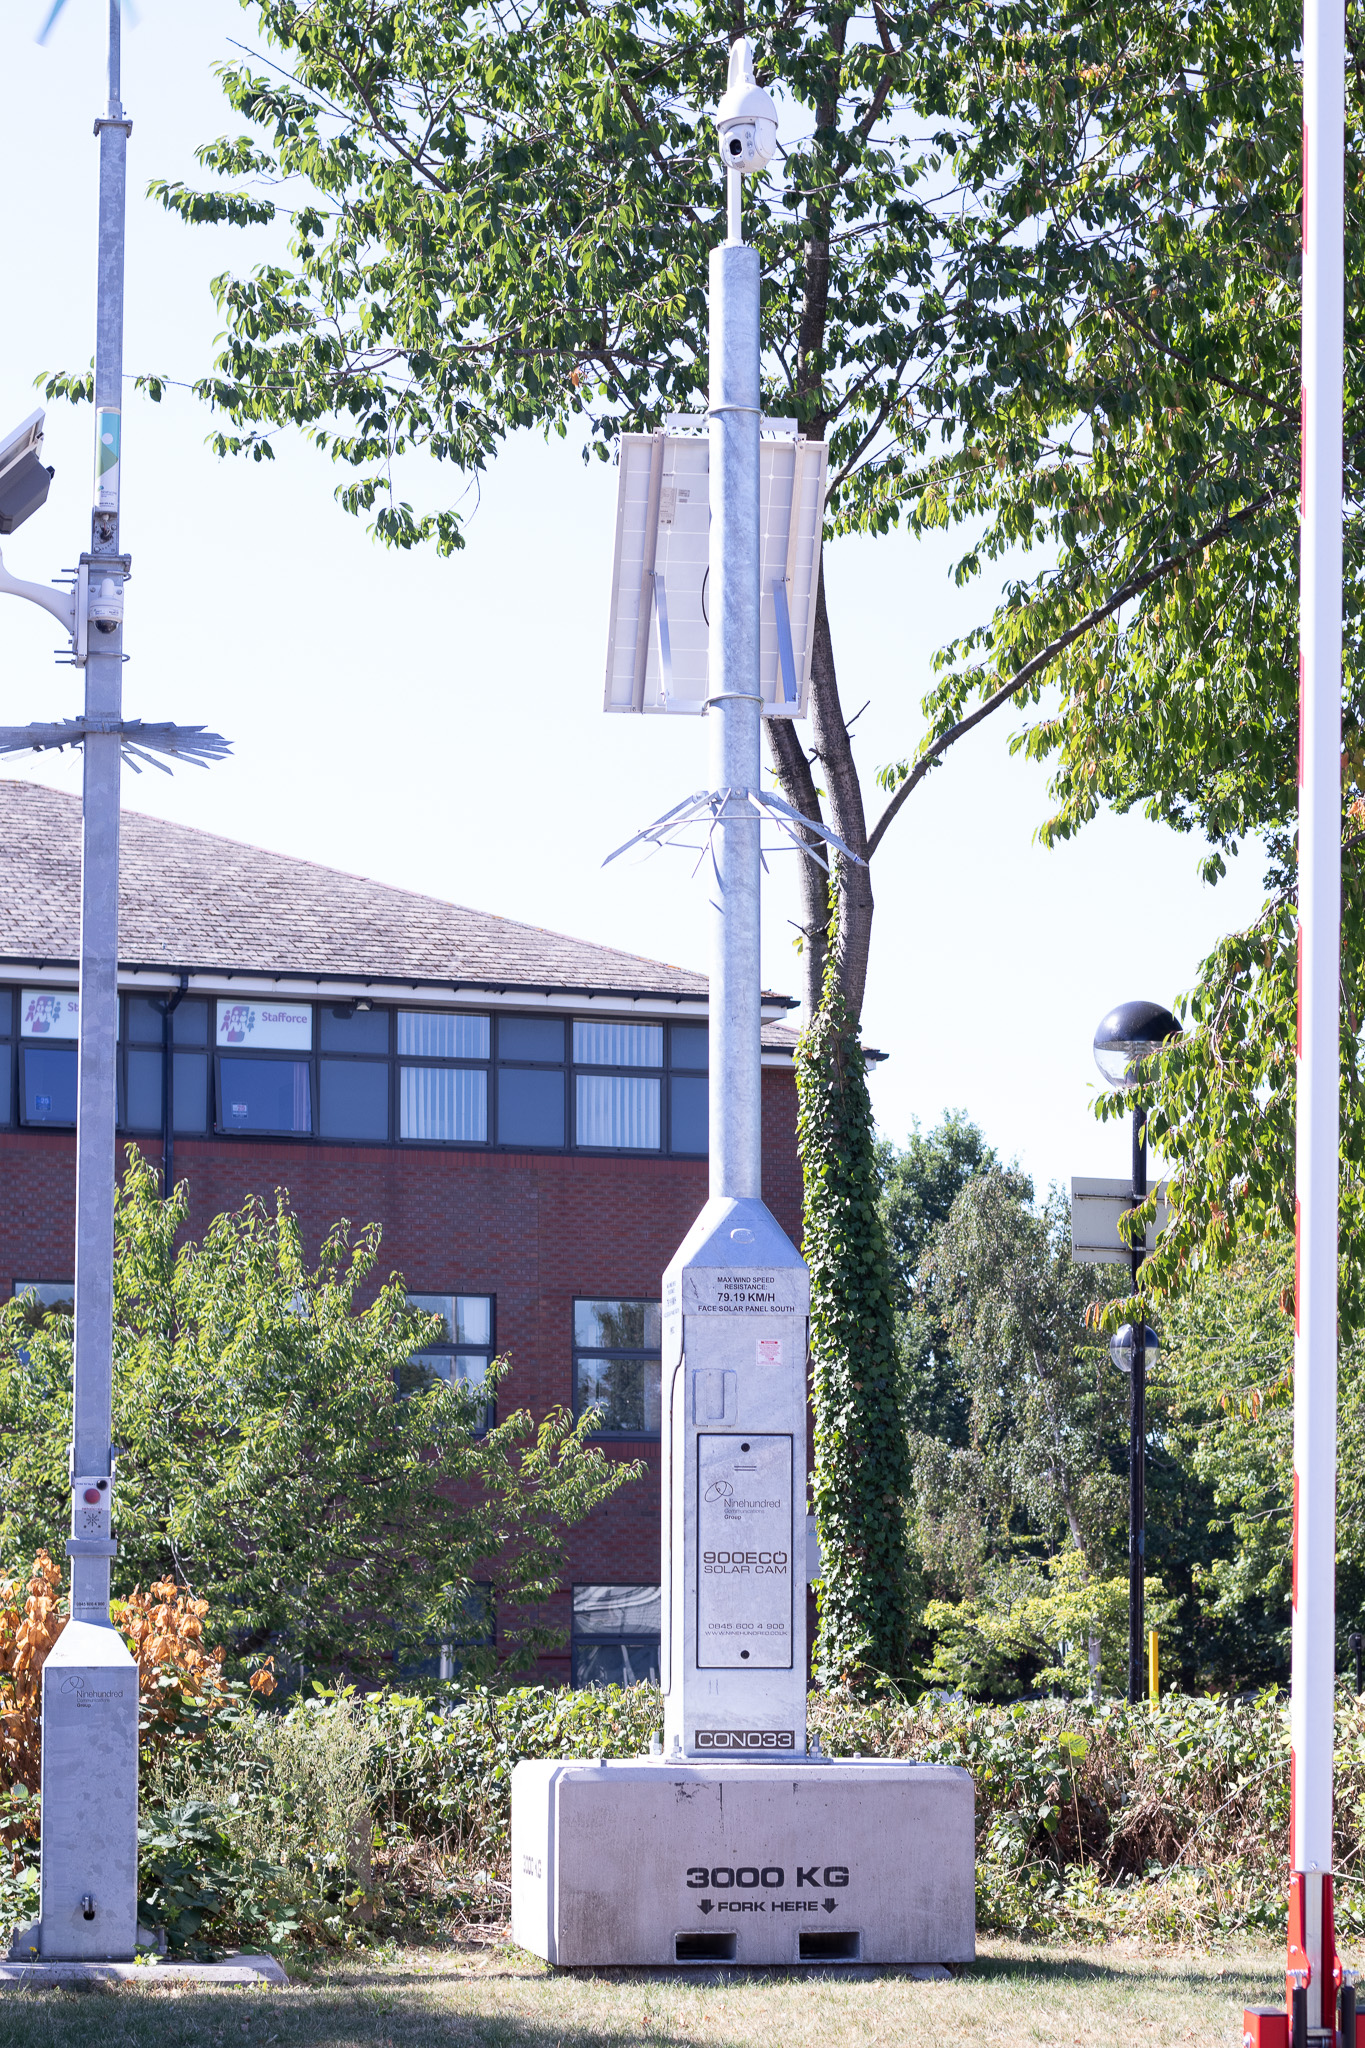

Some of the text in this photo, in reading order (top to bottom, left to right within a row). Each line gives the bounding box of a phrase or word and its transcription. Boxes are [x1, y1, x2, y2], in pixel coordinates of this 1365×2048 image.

[261, 1011, 308, 1024] Stafforce
[717, 1293, 775, 1302] 79.19 KM/H
[770, 1305, 795, 1313] SOUTH
[723, 1499, 781, 1508] Ninehundred
[704, 1565, 787, 1574] SOLAR CAM
[76, 1690, 124, 1698] Ninehundred
[686, 1866, 849, 1889] 3000 KG
[717, 1901, 819, 1912] FORK HERE
